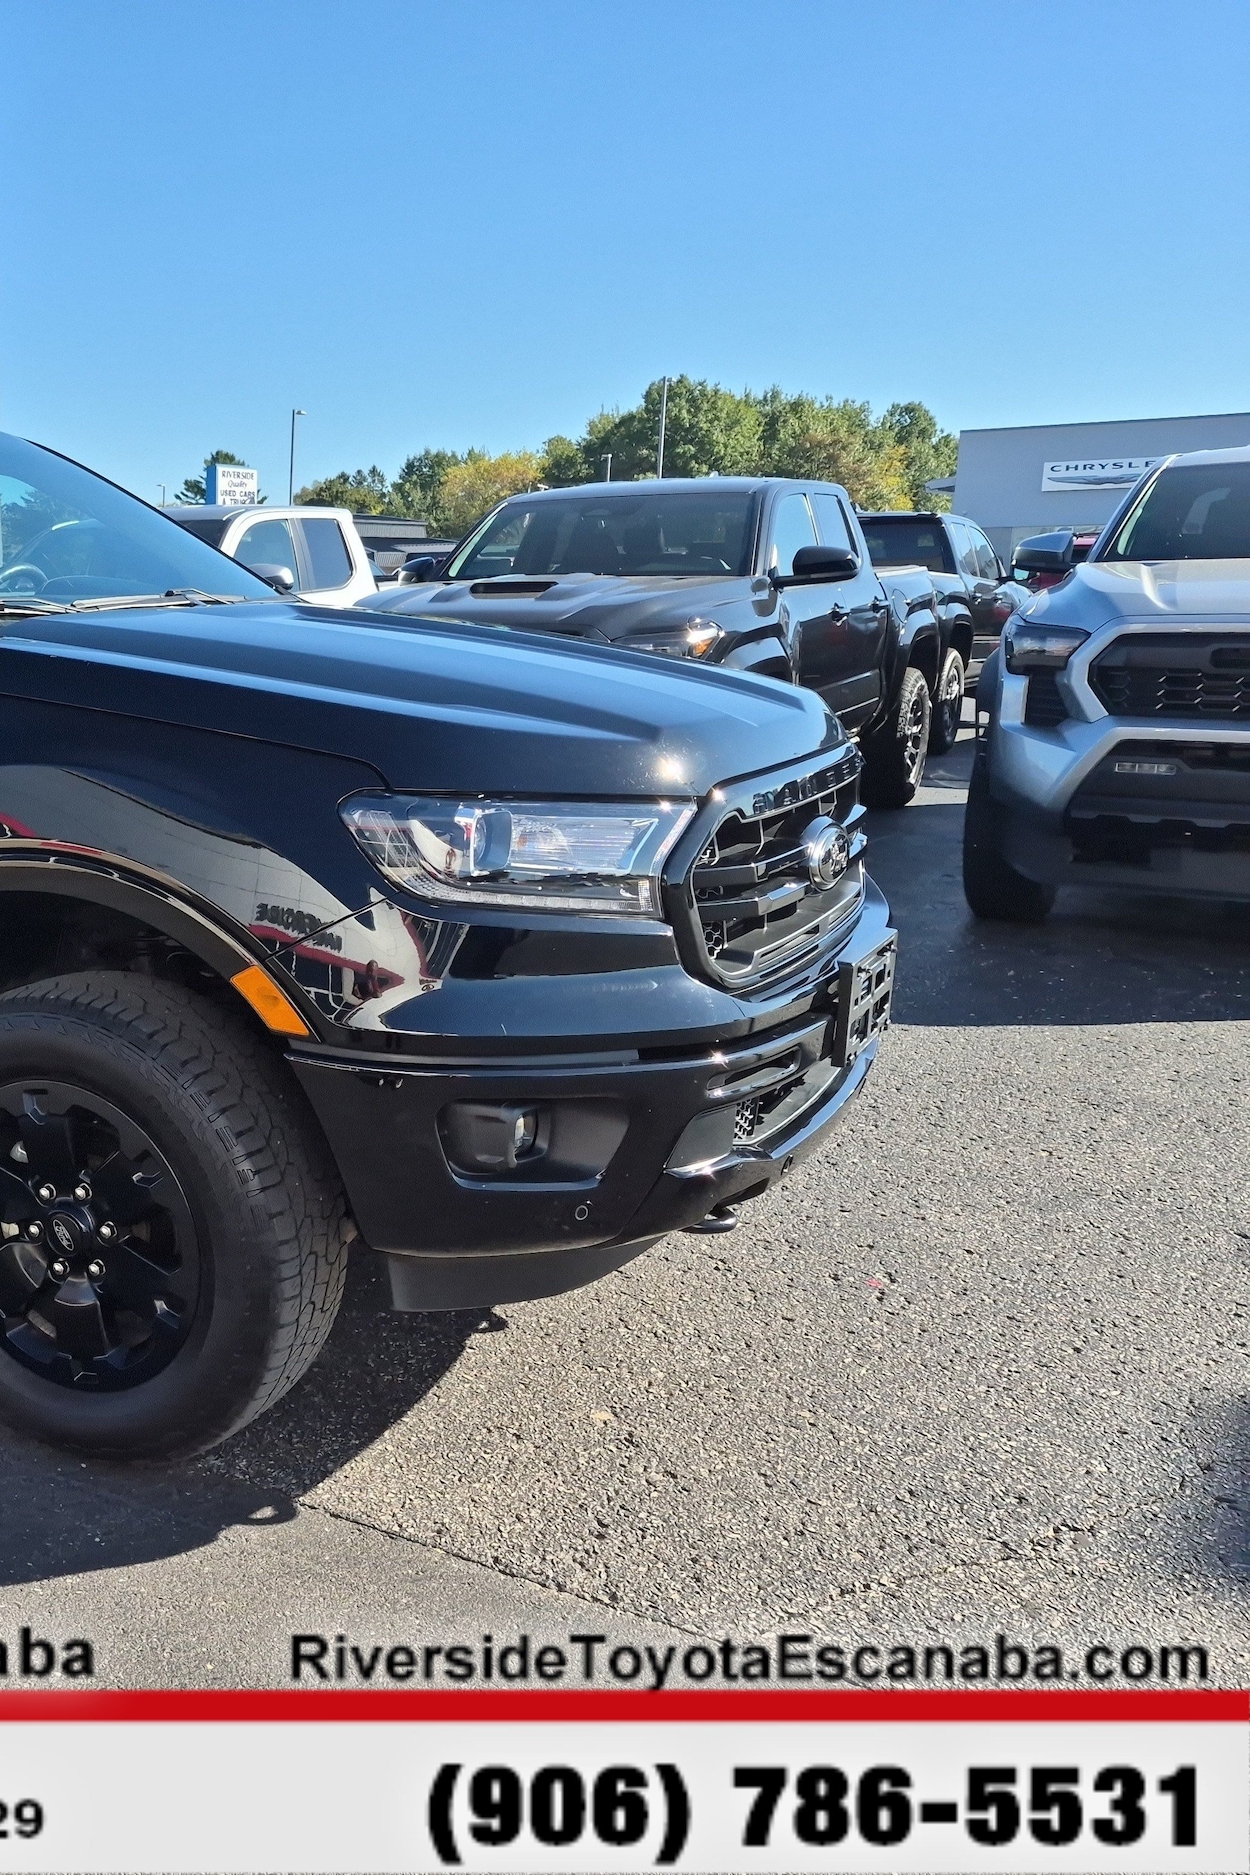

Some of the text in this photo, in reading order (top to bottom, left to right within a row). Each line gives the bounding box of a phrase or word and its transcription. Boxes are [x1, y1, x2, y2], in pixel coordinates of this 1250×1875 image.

[1050, 460, 1157, 473] CHRYSLE
[221, 470, 255, 480] RIVERSIDE
[228, 480, 247, 489] Quality
[239, 490, 255, 498] CARS
